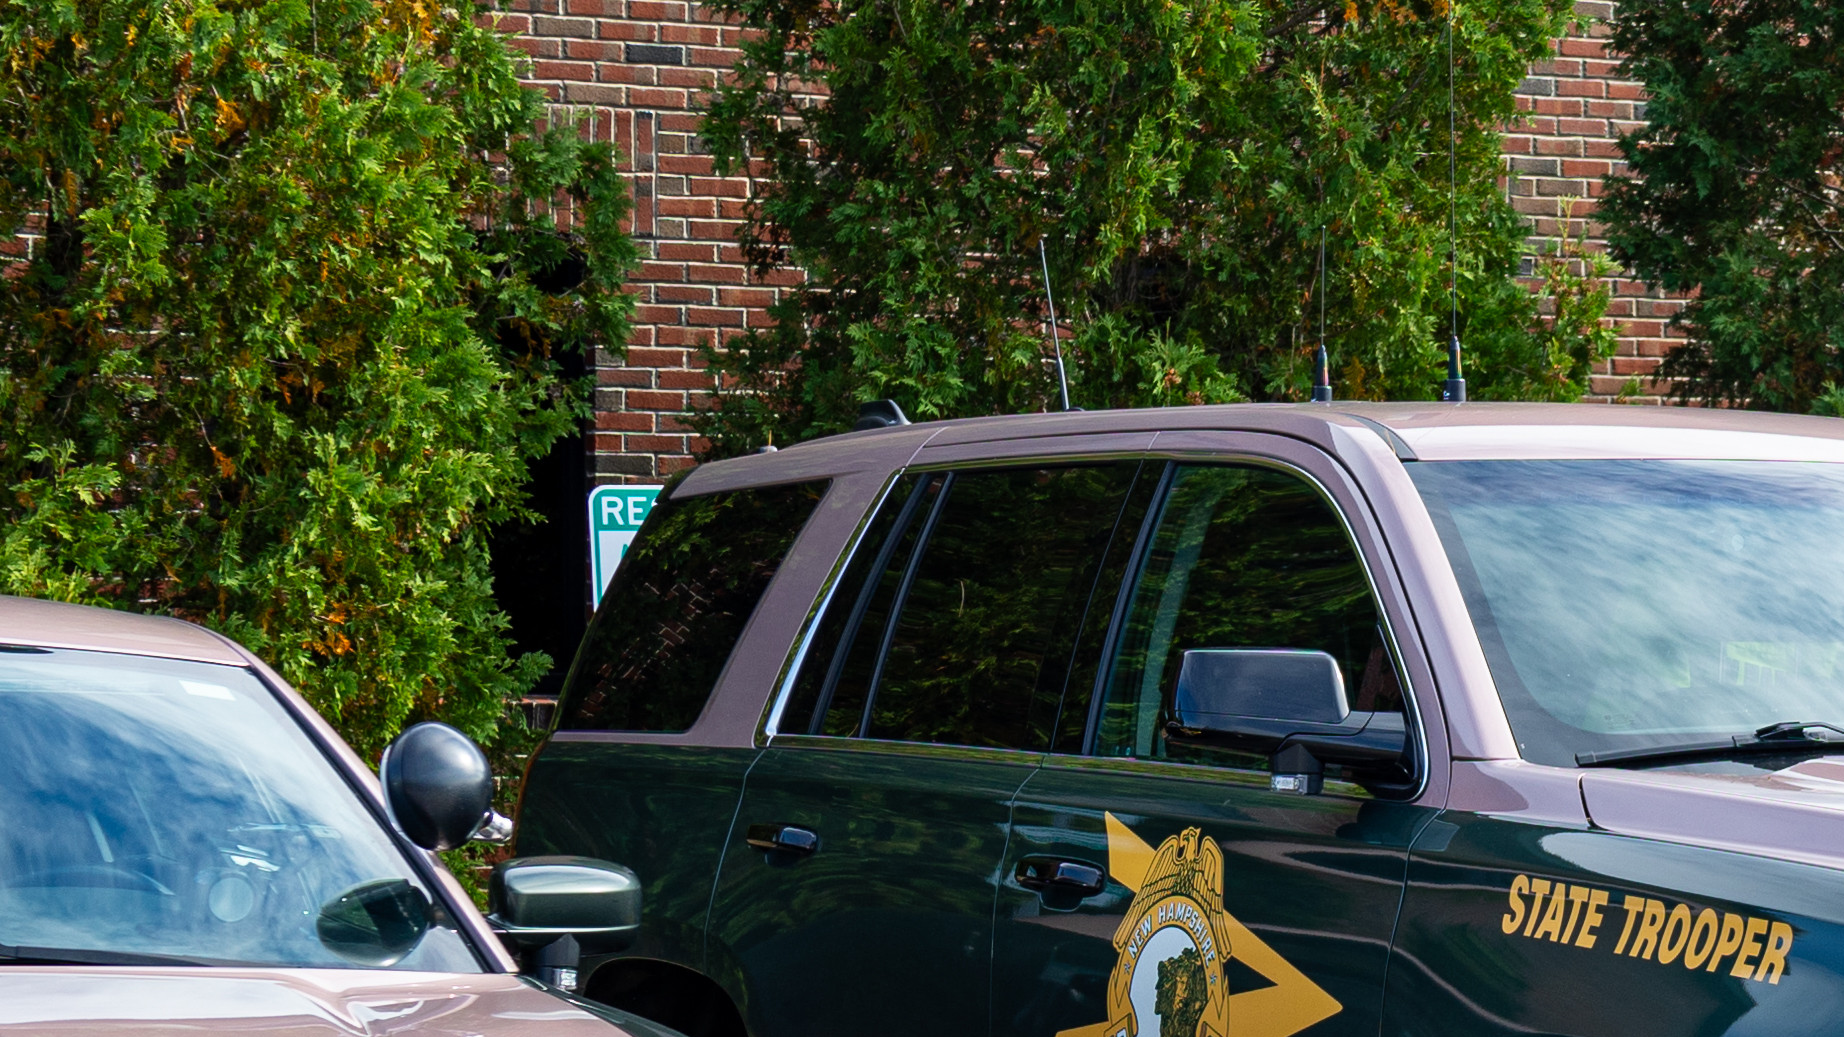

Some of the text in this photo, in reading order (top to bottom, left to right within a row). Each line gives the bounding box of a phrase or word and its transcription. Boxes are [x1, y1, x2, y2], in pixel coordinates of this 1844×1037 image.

[601, 496, 658, 525] RE
[1128, 902, 1216, 967] NEW HAMPSHIRE
[1501, 874, 1794, 985] STATE TROOPER
